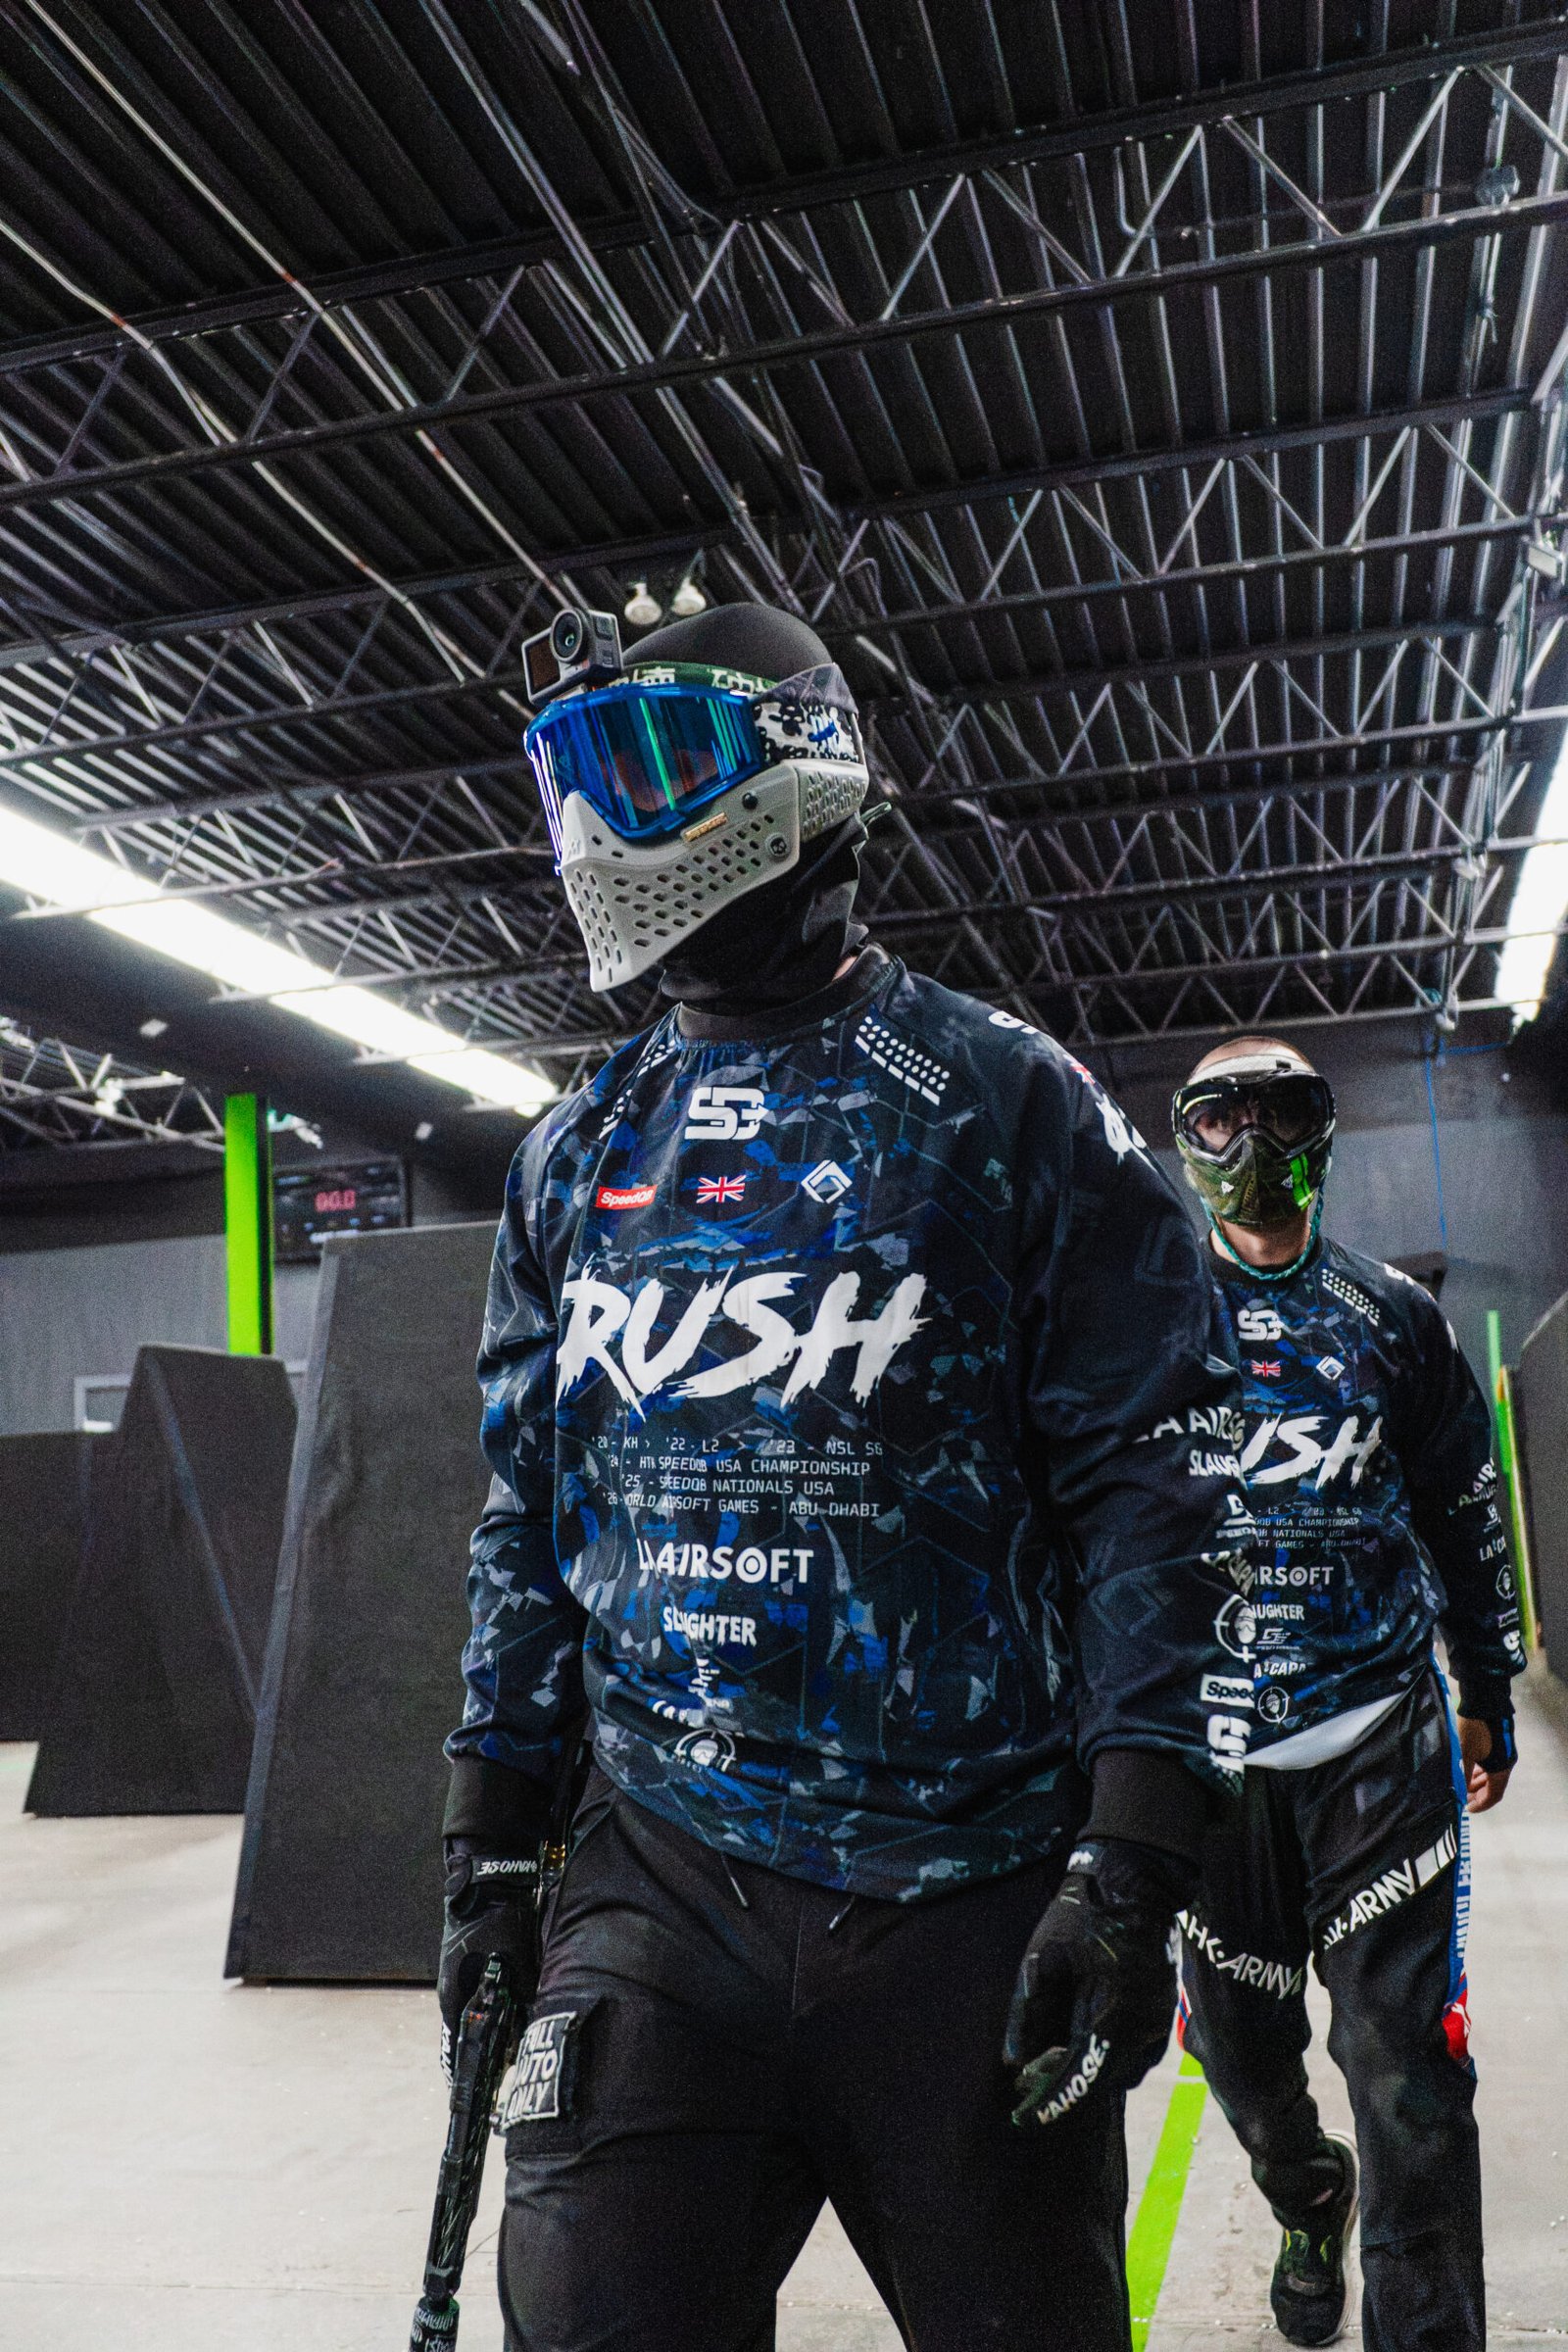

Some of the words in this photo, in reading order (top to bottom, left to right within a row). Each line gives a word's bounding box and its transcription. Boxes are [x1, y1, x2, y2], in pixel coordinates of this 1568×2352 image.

[601, 1189, 655, 1207] SpeedQB
[556, 1254, 932, 1420] RUSH
[623, 1437, 638, 1448] KH
[702, 1439, 719, 1452] L2
[826, 1441, 856, 1455] NSL
[715, 1459, 742, 1473] USA
[751, 1459, 870, 1476] CHAMPIONSHIP
[712, 1479, 794, 1494] NATIONALS
[804, 1481, 834, 1495] USA
[718, 1498, 760, 1514] GAMES
[789, 1501, 818, 1516] ABU
[829, 1502, 880, 1518] DHABI
[1276, 1518, 1294, 1527] USA
